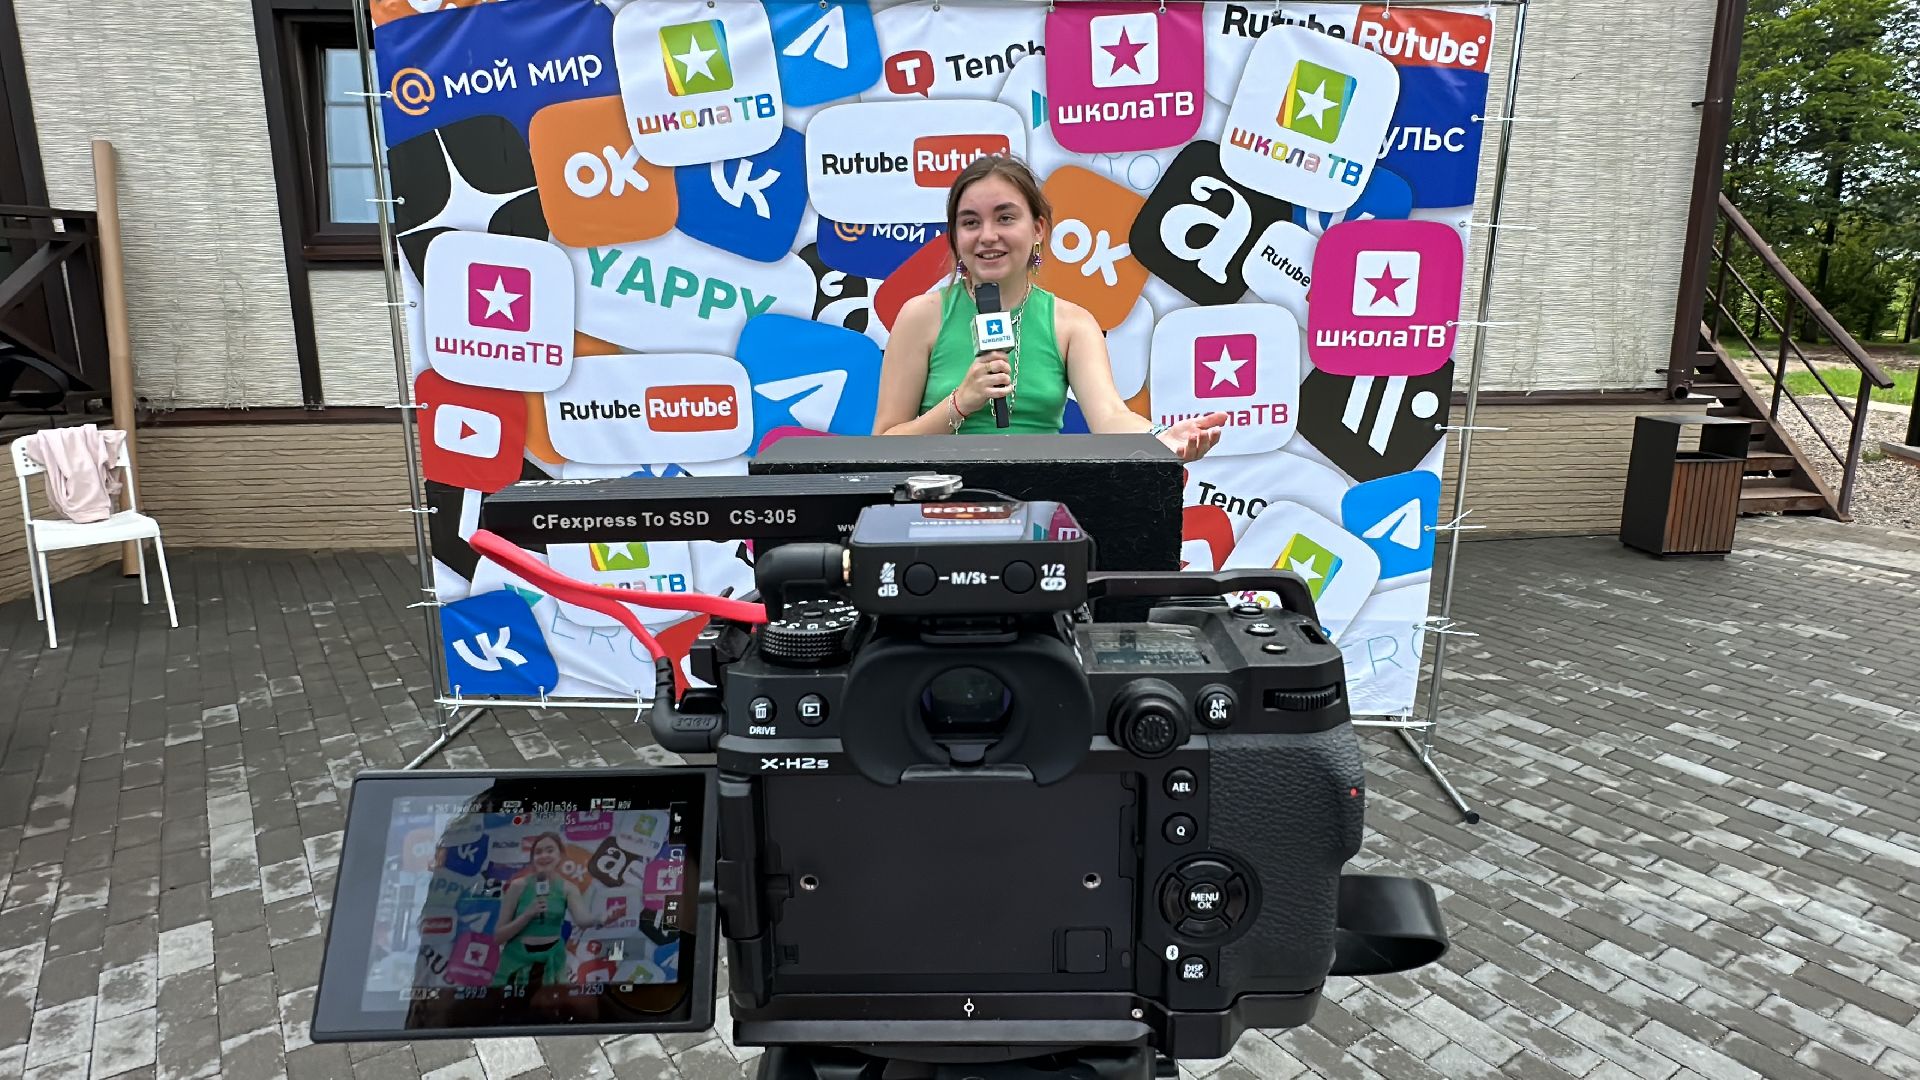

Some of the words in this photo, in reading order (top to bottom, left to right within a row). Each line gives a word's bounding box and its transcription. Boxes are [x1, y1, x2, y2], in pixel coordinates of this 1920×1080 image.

[1358, 20, 1480, 67] Rutube
[1058, 90, 1195, 125] школаТВ
[821, 151, 909, 175] Rutube
[917, 147, 1003, 172] Rutu
[1261, 245, 1312, 288] Rutube
[1315, 324, 1447, 349] школаТВ
[434, 335, 564, 367] школаТВ
[560, 399, 641, 421] Rutube
[649, 395, 732, 419] Rutube
[532, 513, 638, 532] CFexpress
[642, 511, 665, 527] To
[669, 510, 710, 527] SSD
[729, 508, 797, 526] CS-305
[1041, 563, 1066, 577] 1/2
[878, 583, 899, 598] dB
[1210, 699, 1226, 710] AF
[1209, 709, 1228, 720] ON
[749, 725, 777, 736] DRIVE
[760, 757, 830, 771] X-H2s
[1171, 782, 1192, 793] AEL
[1176, 825, 1187, 837] Q
[1190, 891, 1220, 902] MENU
[1197, 901, 1213, 909] OK
[1183, 971, 1204, 979] BACK
[1184, 963, 1204, 973] DISP
